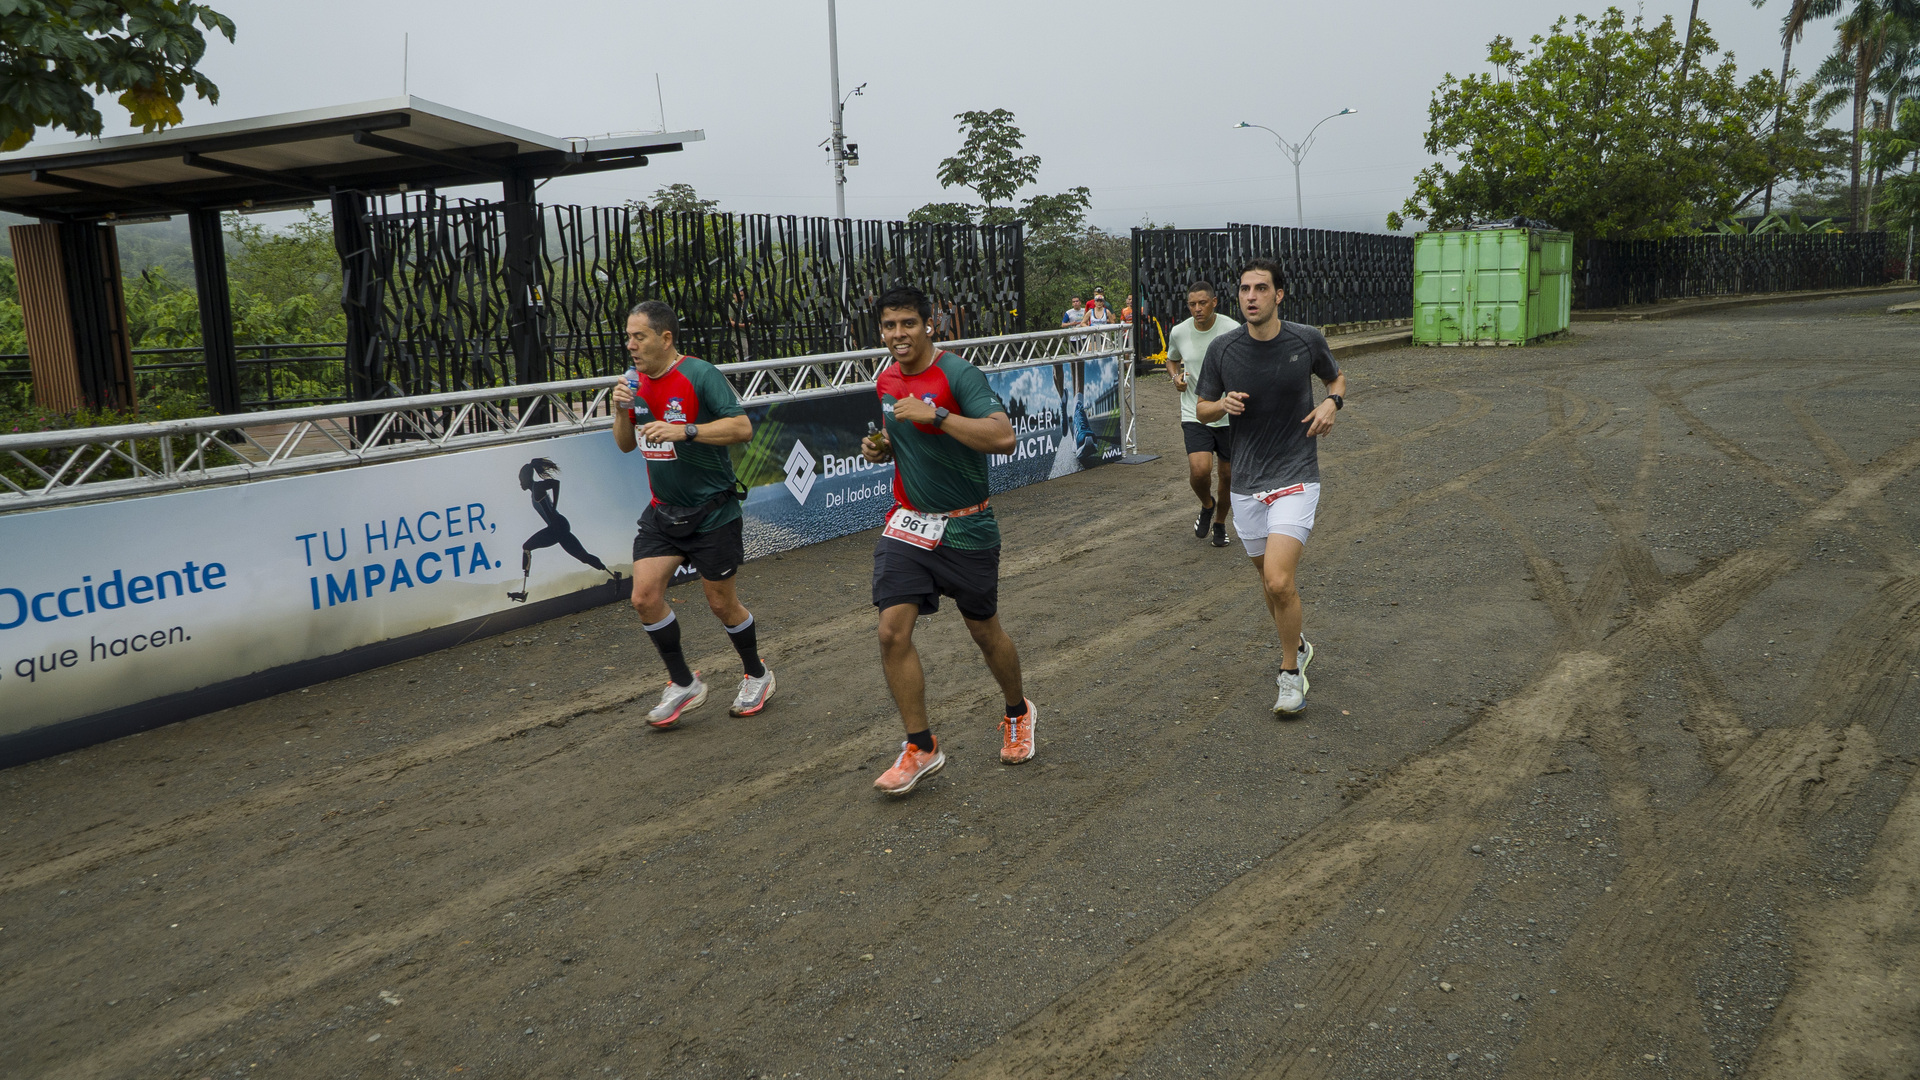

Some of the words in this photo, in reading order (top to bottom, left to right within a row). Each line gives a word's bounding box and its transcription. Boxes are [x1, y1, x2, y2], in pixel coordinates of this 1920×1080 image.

[1102, 447, 1122, 460] AVAL
[826, 488, 844, 508] Del
[847, 484, 871, 503] lado
[873, 480, 886, 496] de
[295, 527, 347, 567] TU
[365, 502, 497, 554] HACER,
[901, 516, 929, 534] 961
[0, 561, 227, 630] Occidente
[310, 541, 502, 610] IMPACTA.
[15, 649, 78, 682] que
[91, 626, 191, 662] hacen.
